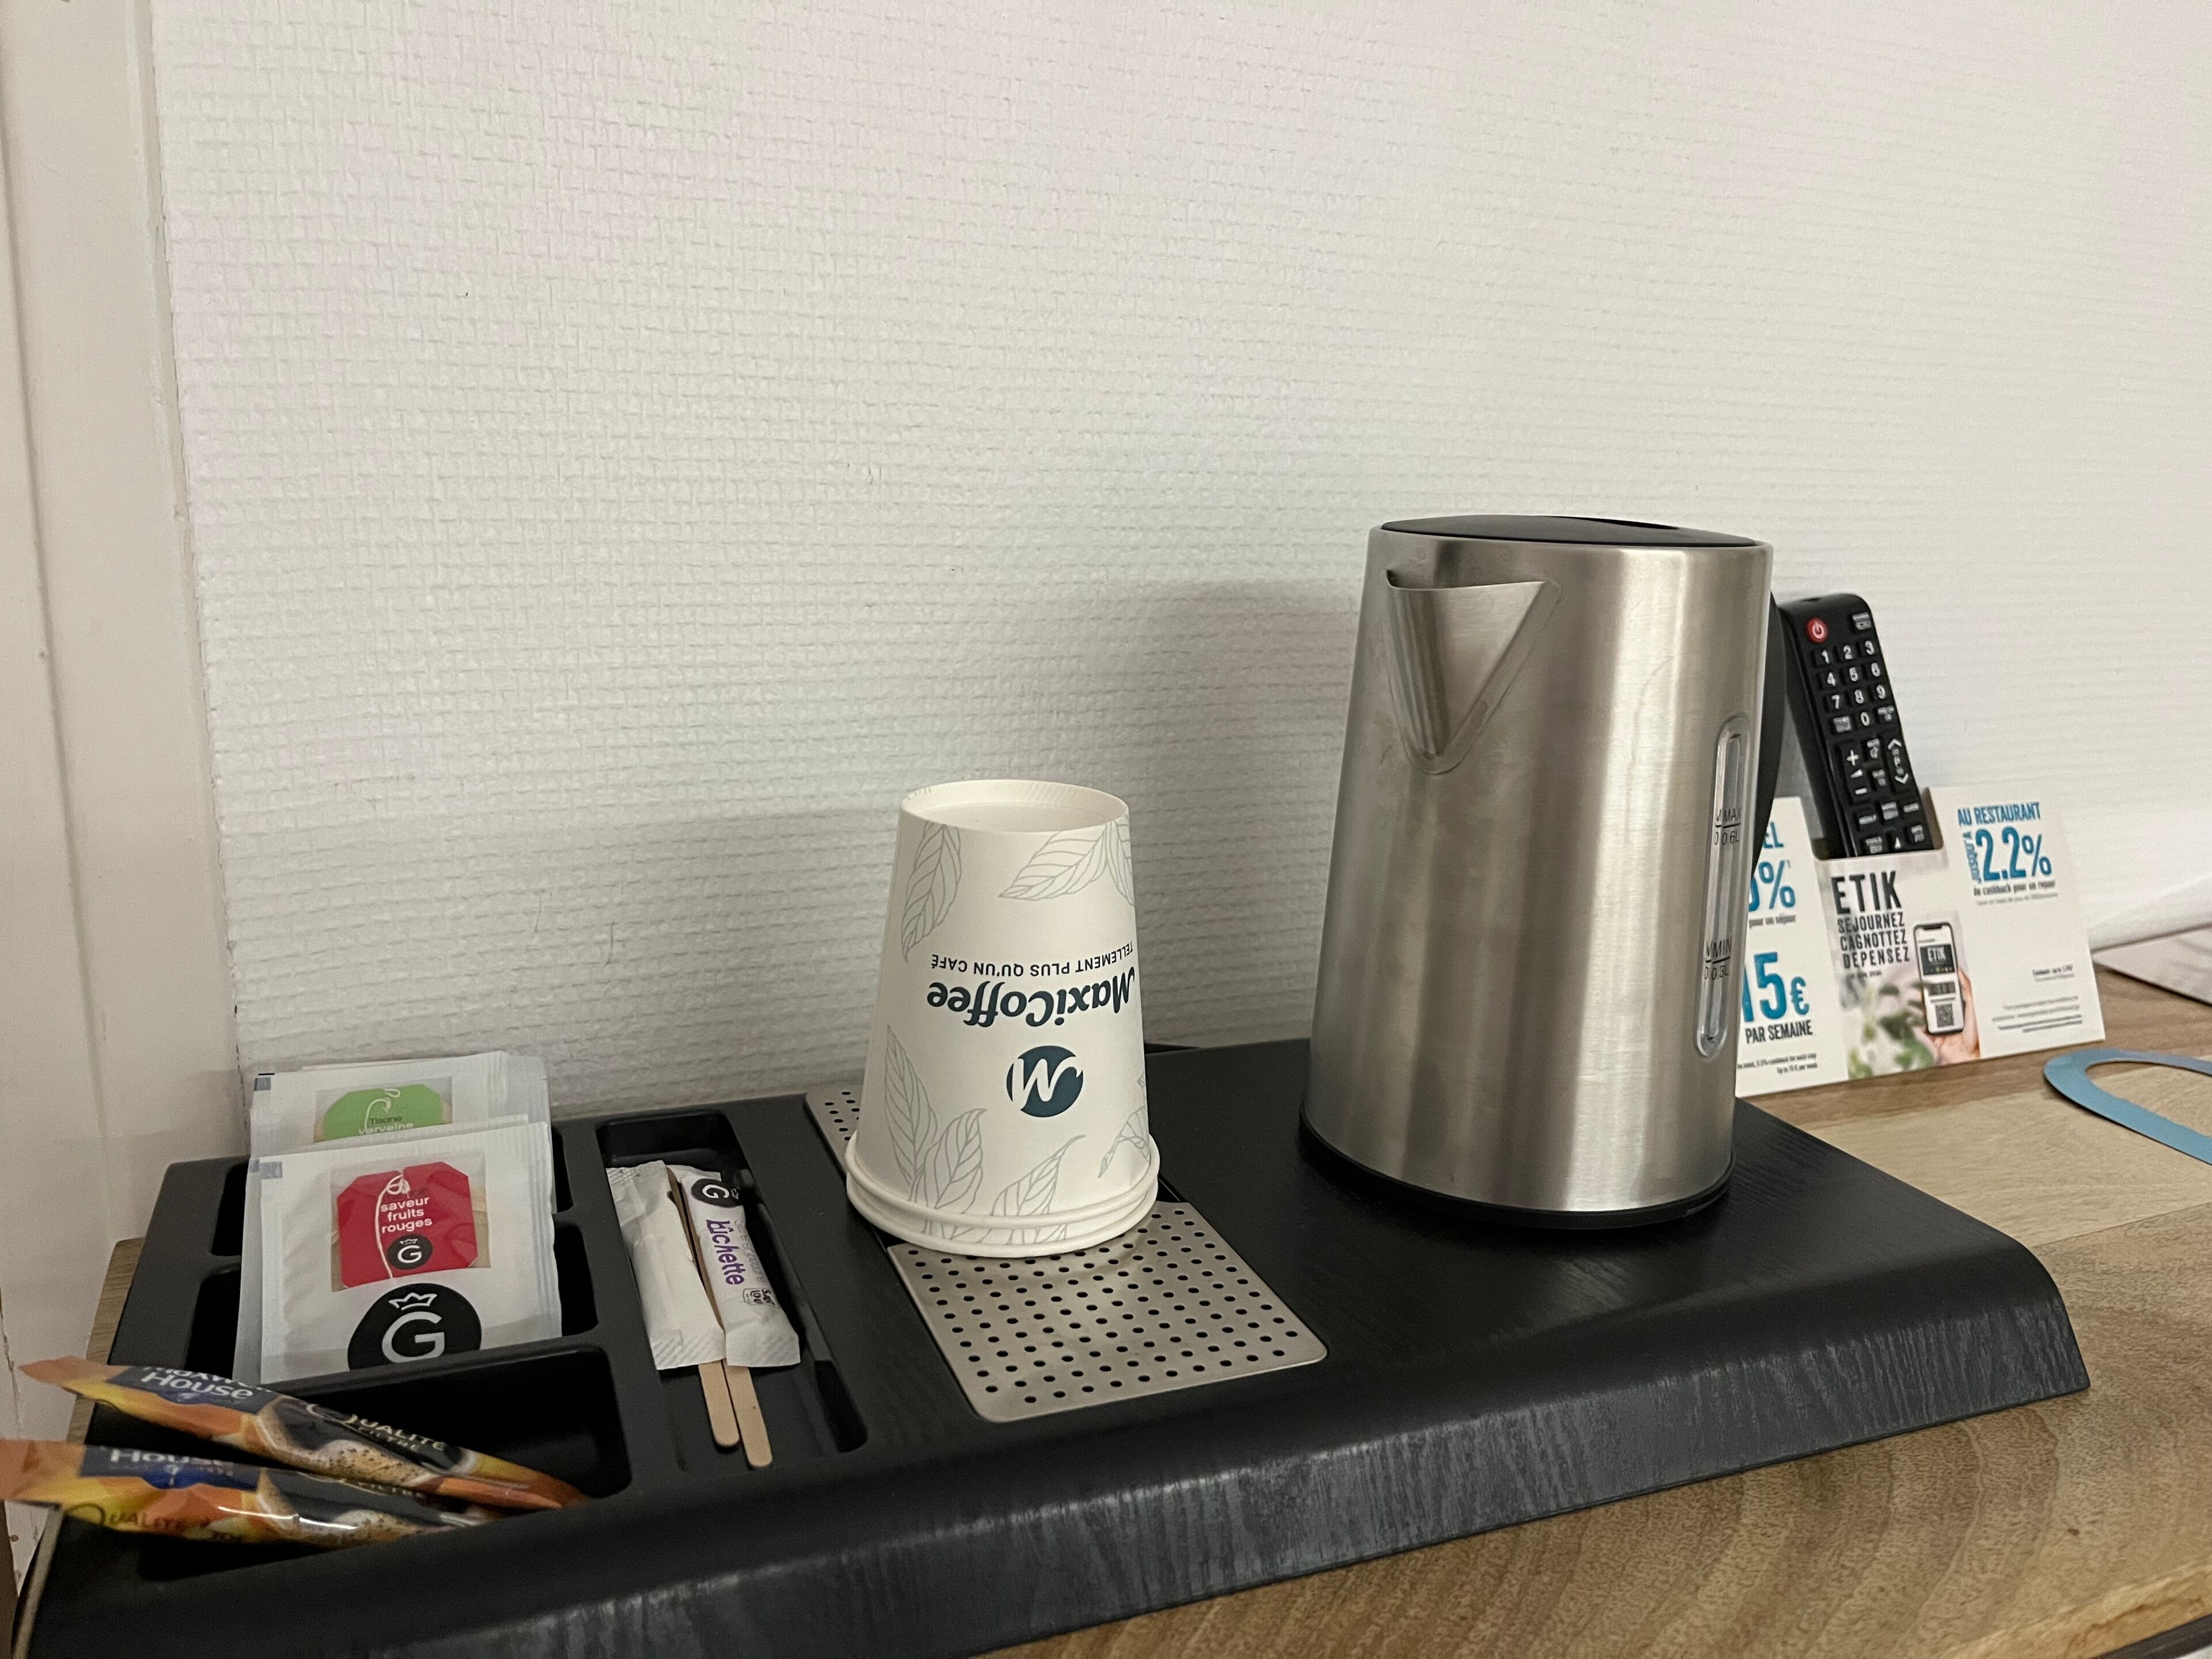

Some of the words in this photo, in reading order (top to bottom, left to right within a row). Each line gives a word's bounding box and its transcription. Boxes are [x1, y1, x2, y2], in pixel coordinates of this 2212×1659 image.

[1821, 650, 1830, 664] 1
[1843, 645, 1853, 660] 2
[1865, 640, 1874, 655] 3
[1827, 672, 1836, 687] 4
[1849, 666, 1858, 681] 5
[1871, 662, 1880, 677] 6
[1831, 694, 1840, 709] 7
[1854, 689, 1864, 704] 8
[1876, 684, 1886, 699] 9
[1860, 711, 1870, 726] 0
[1723, 808, 1741, 823] MAX
[1957, 808, 1972, 827] AU
[1974, 802, 2040, 824] RESTAURANT
[1975, 825, 2052, 882] 2.2%
[1831, 870, 1901, 914] ETIK
[1711, 937, 1732, 957] MIN
[1840, 929, 1907, 952] CAGNOTTEZ
[931, 953, 968, 972] CAFÉ
[1075, 941, 1134, 973] TELLEMENT
[974, 962, 1024, 978] QU'UN
[1030, 963, 1070, 977] PLUS
[926, 966, 1135, 1028] MaxiCoffee
[1745, 1027, 1766, 1044] PAR
[1768, 1020, 1813, 1040] SEMAINE
[702, 1184, 730, 1199] G
[380, 1197, 430, 1211] saveur
[387, 1208, 425, 1222] fruits
[381, 1218, 433, 1234] rouges
[397, 1245, 422, 1264] G
[382, 1311, 445, 1363] G
[141, 1372, 253, 1399] House
